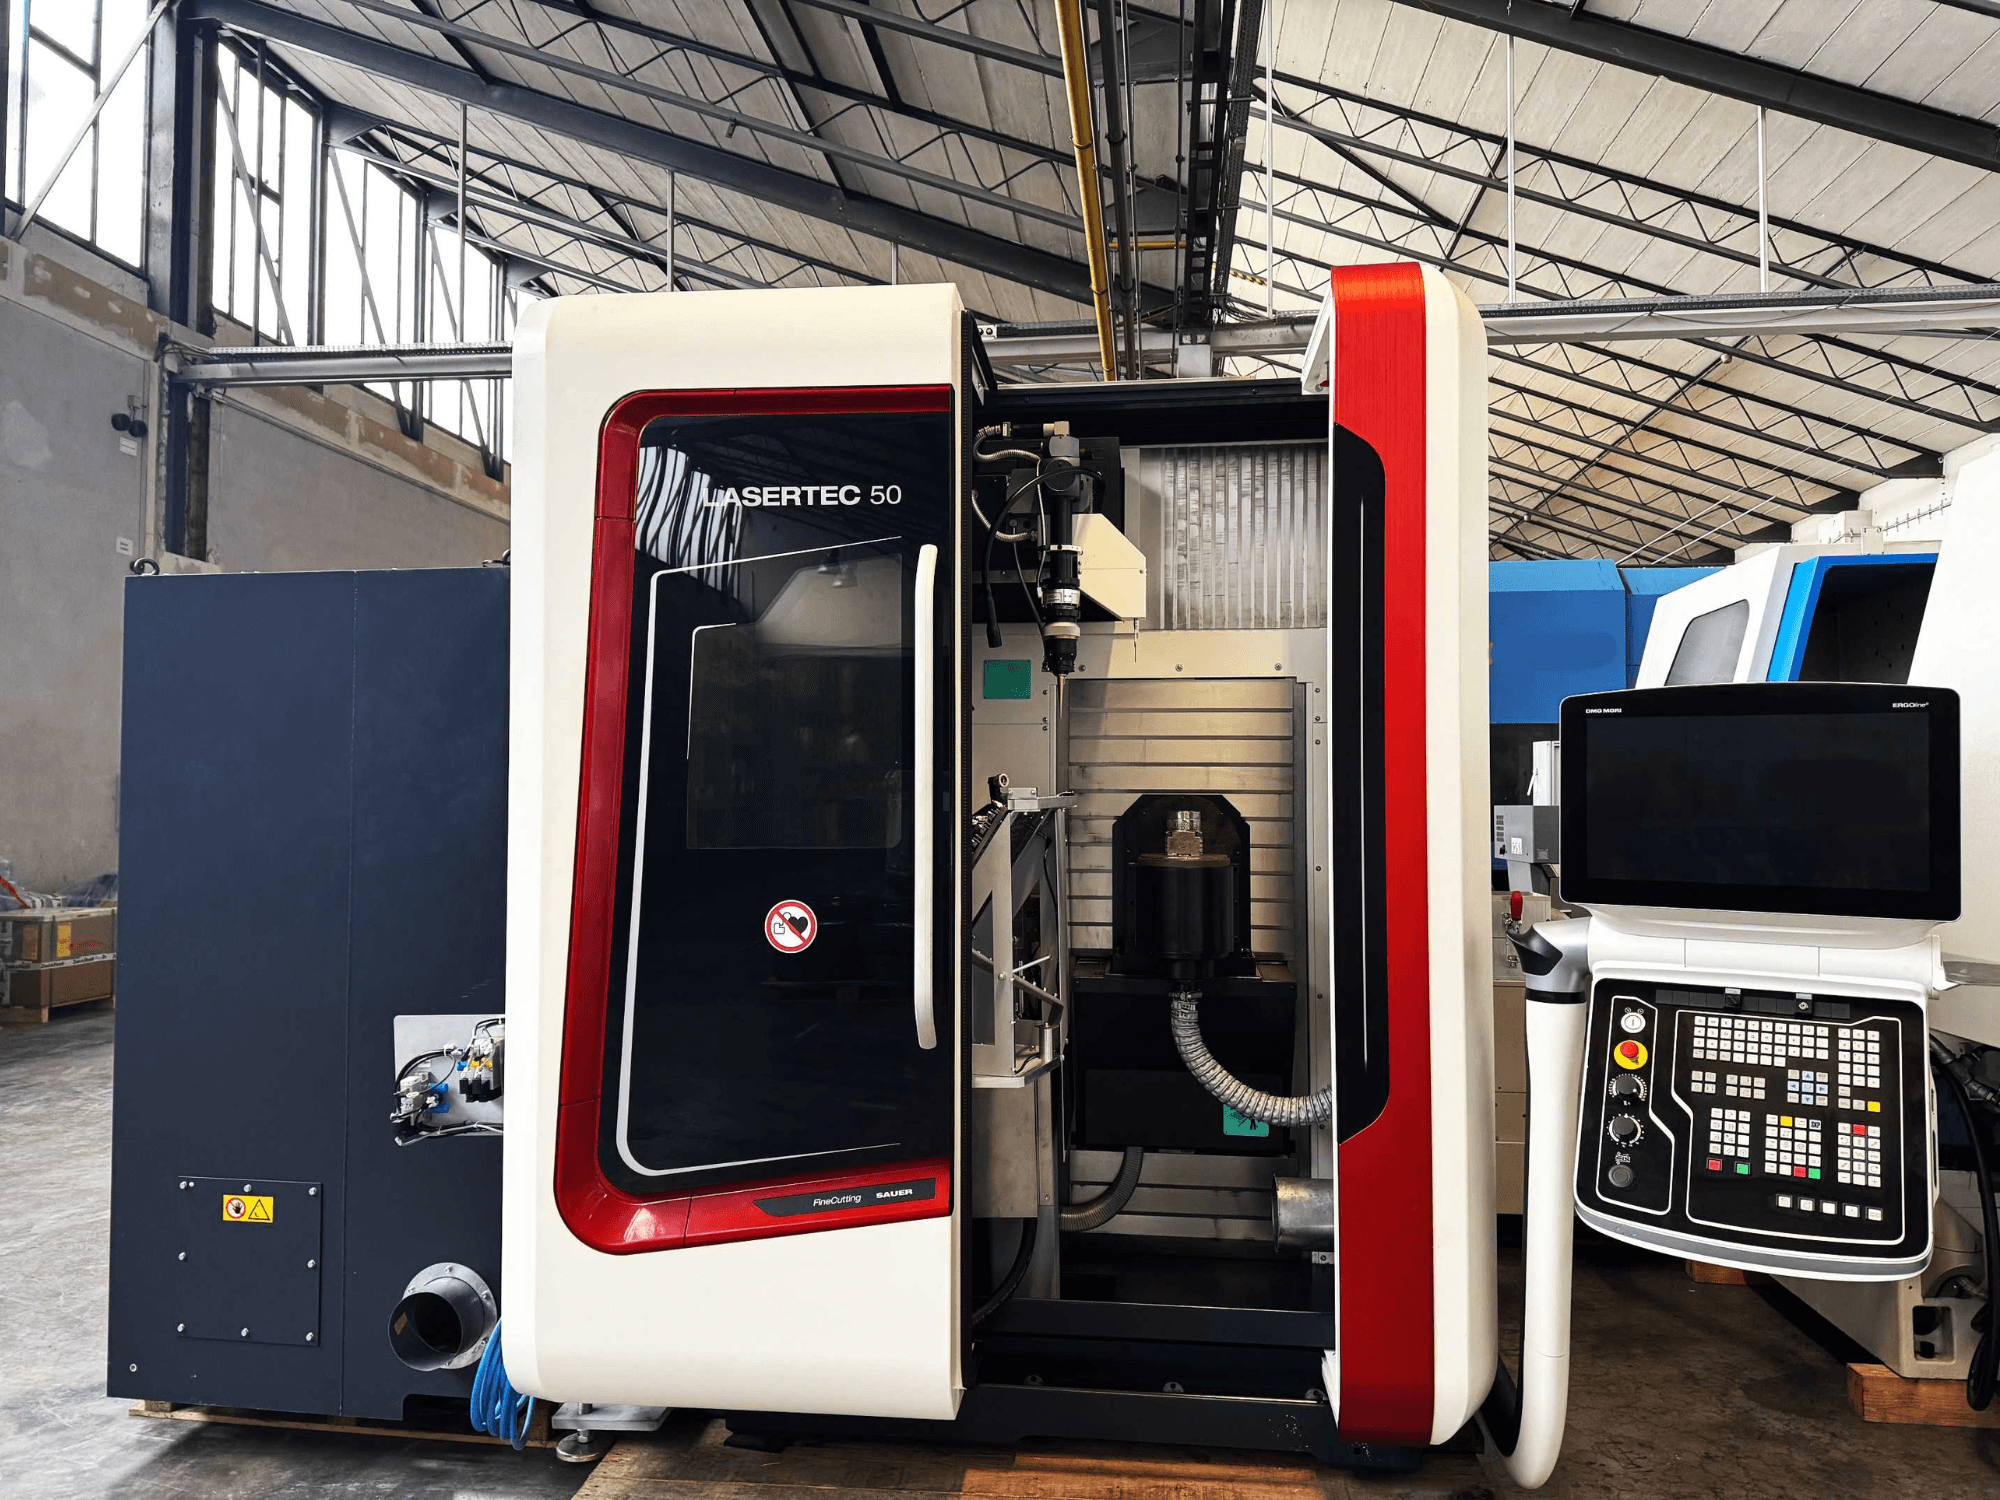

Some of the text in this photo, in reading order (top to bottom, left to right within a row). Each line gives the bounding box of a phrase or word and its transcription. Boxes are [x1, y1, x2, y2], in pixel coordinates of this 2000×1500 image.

[703, 485, 902, 506] LASERTEC 50
[813, 1188, 913, 1207] FineCutting SAUER
